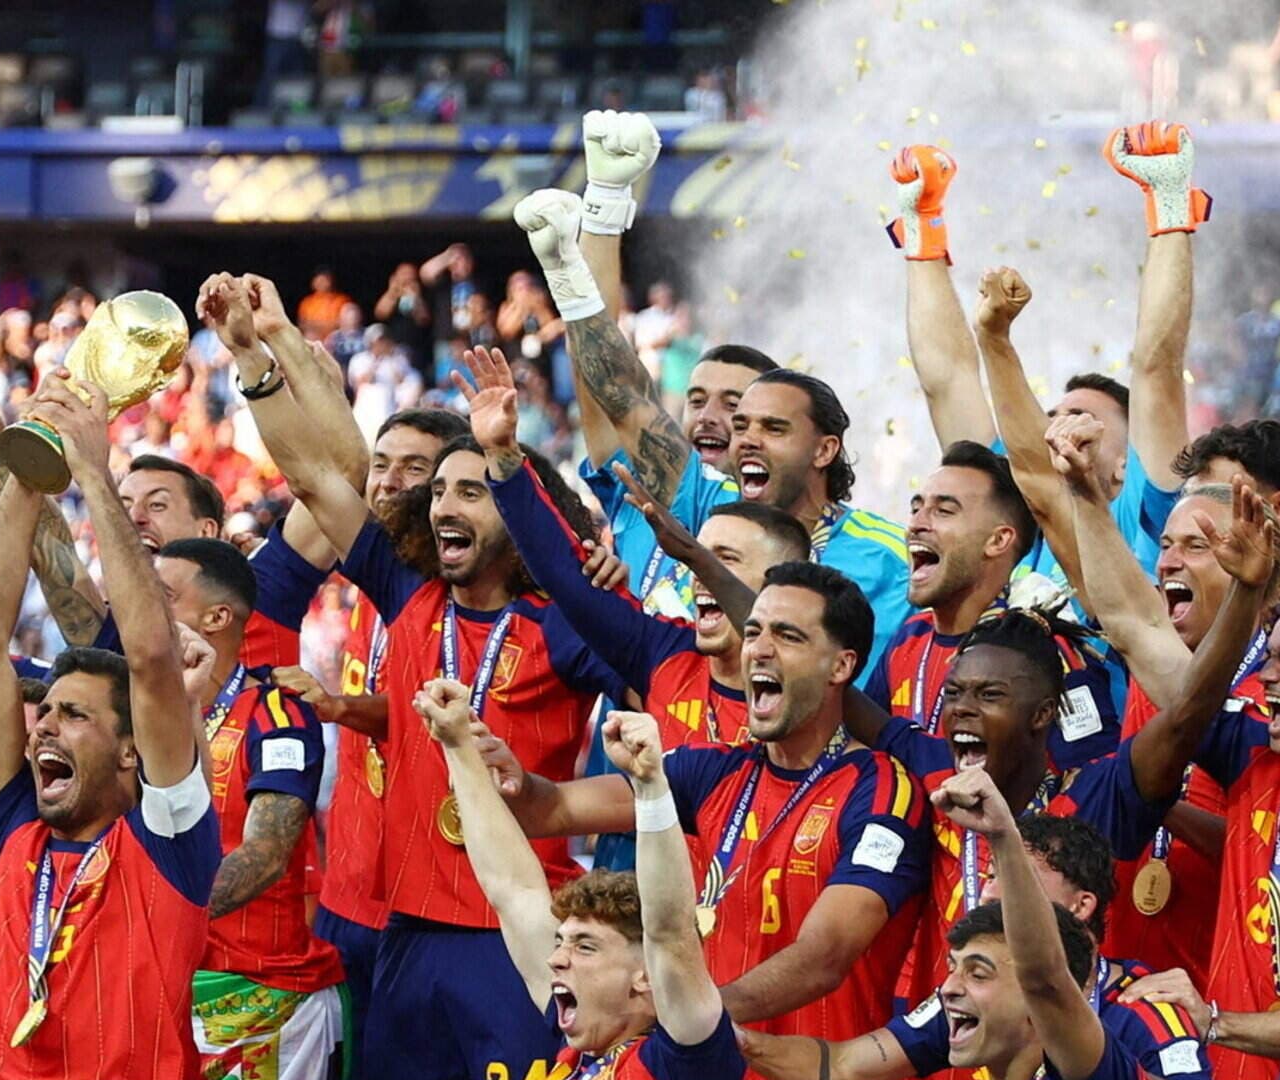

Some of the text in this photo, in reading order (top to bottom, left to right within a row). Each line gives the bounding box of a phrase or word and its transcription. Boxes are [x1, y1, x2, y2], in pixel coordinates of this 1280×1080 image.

[477, 659, 492, 693] WORLD
[487, 640, 497, 659] CUP
[1244, 648, 1259, 664] CUP
[760, 868, 782, 934] 6
